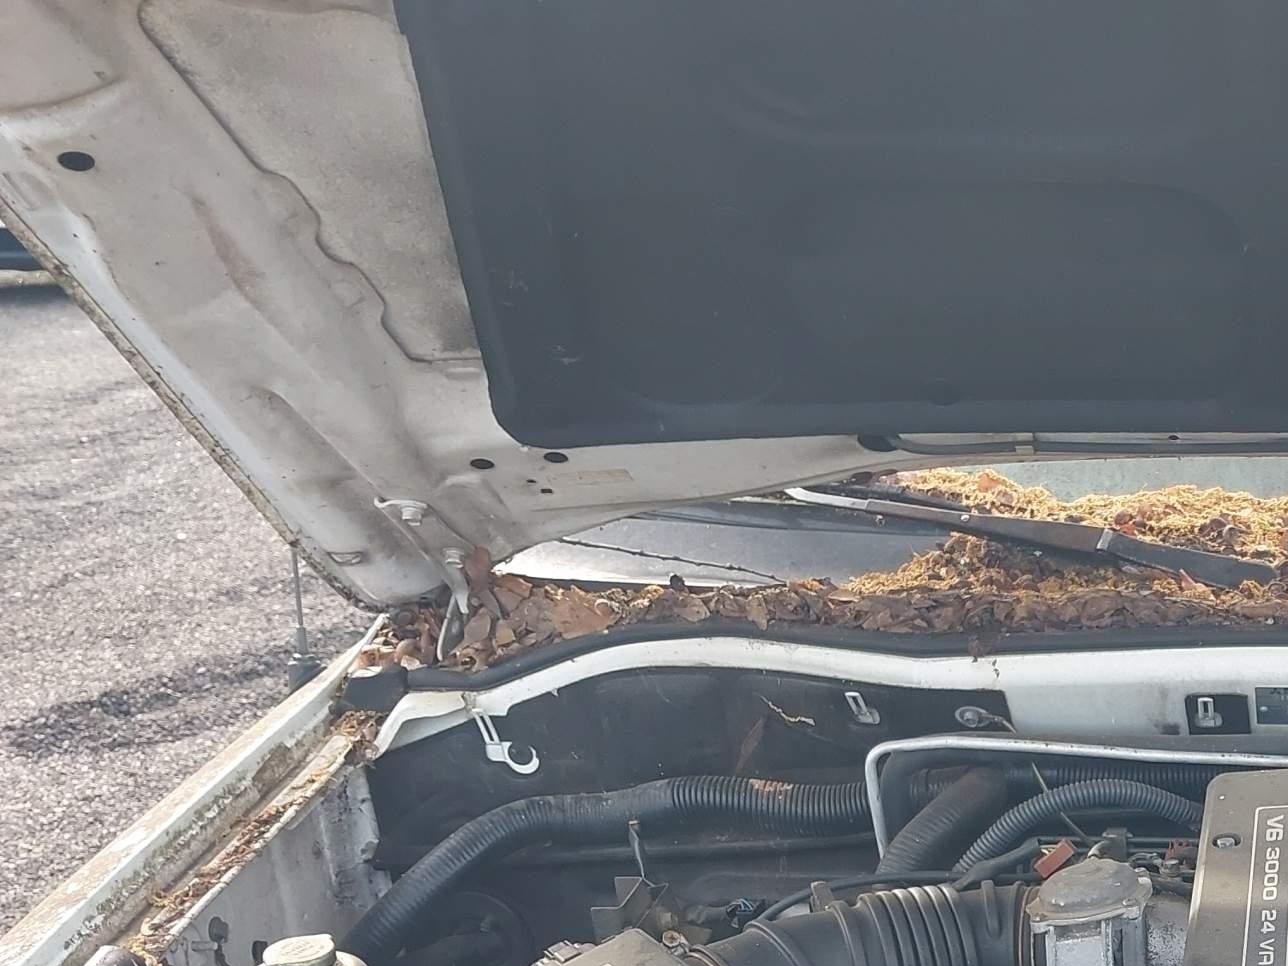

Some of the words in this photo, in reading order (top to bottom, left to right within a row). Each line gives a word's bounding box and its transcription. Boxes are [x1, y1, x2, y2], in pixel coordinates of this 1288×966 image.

[1265, 814, 1285, 842] V6
[1262, 847, 1280, 901] 3000
[1260, 909, 1277, 934] 24
